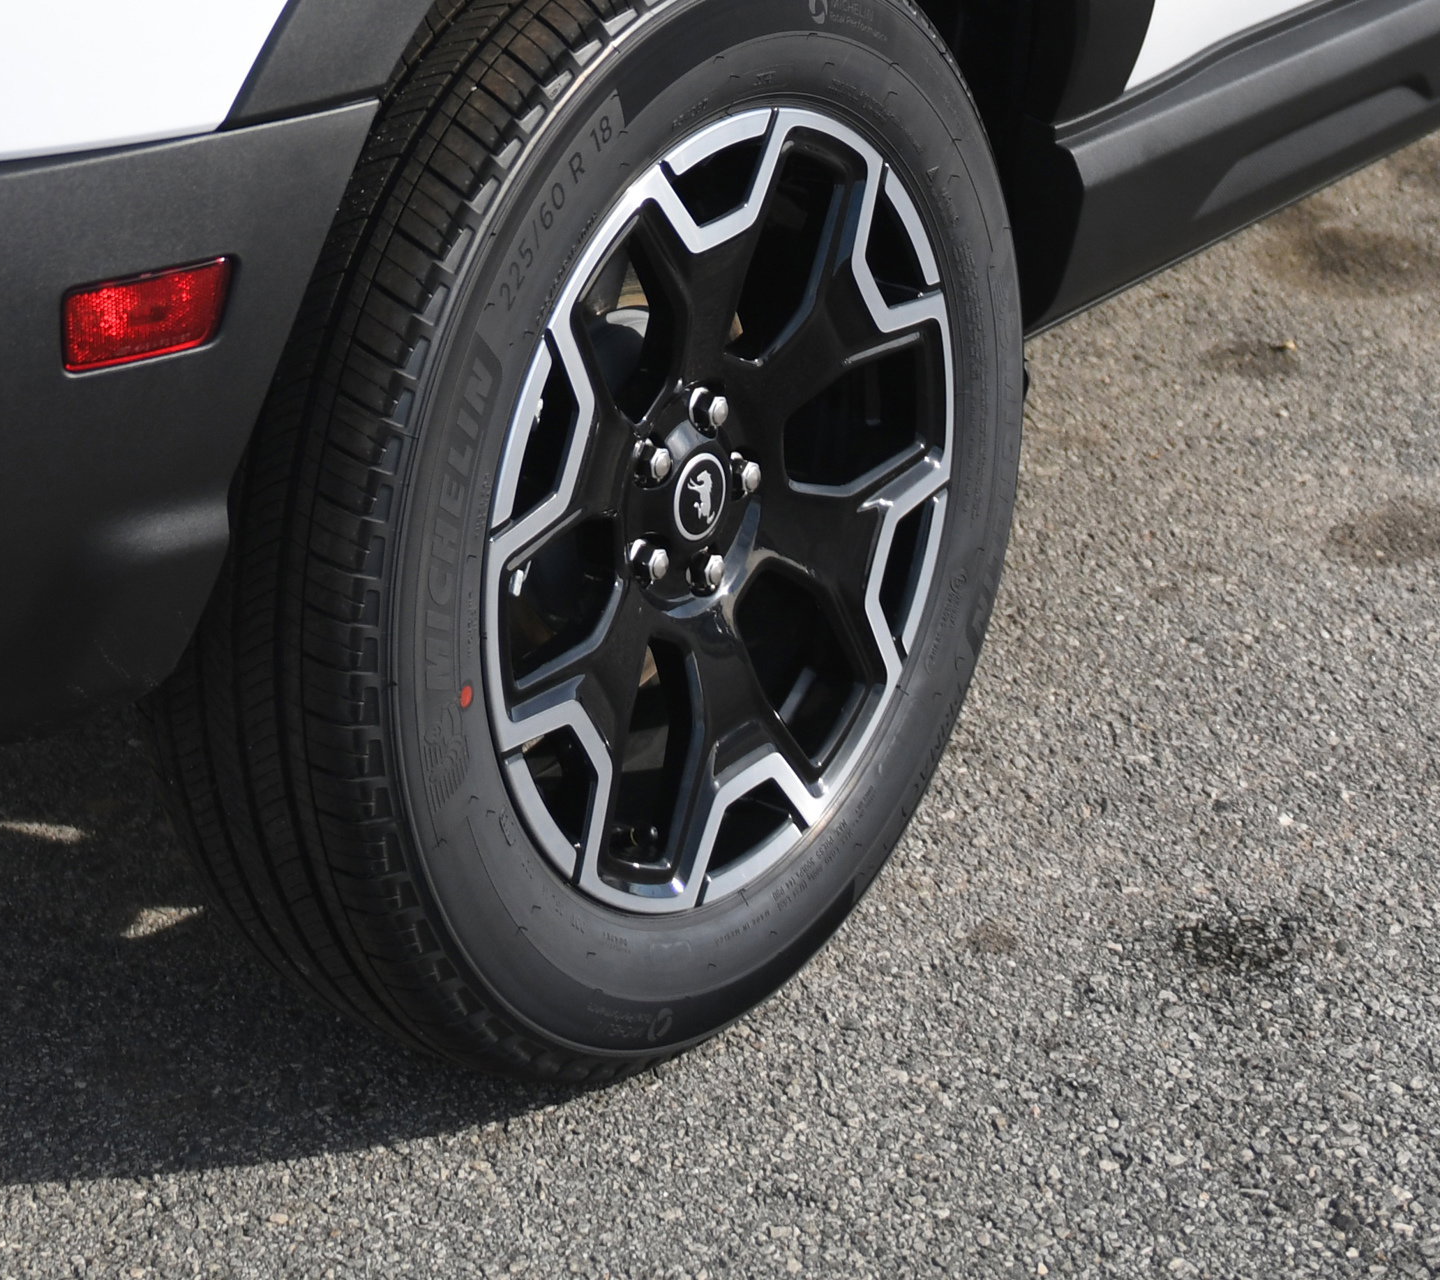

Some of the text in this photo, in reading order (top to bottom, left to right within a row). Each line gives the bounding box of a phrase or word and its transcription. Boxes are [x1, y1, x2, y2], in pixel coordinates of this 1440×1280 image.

[498, 114, 614, 309] 225/60 R 18
[425, 355, 496, 690] MICHELIN
